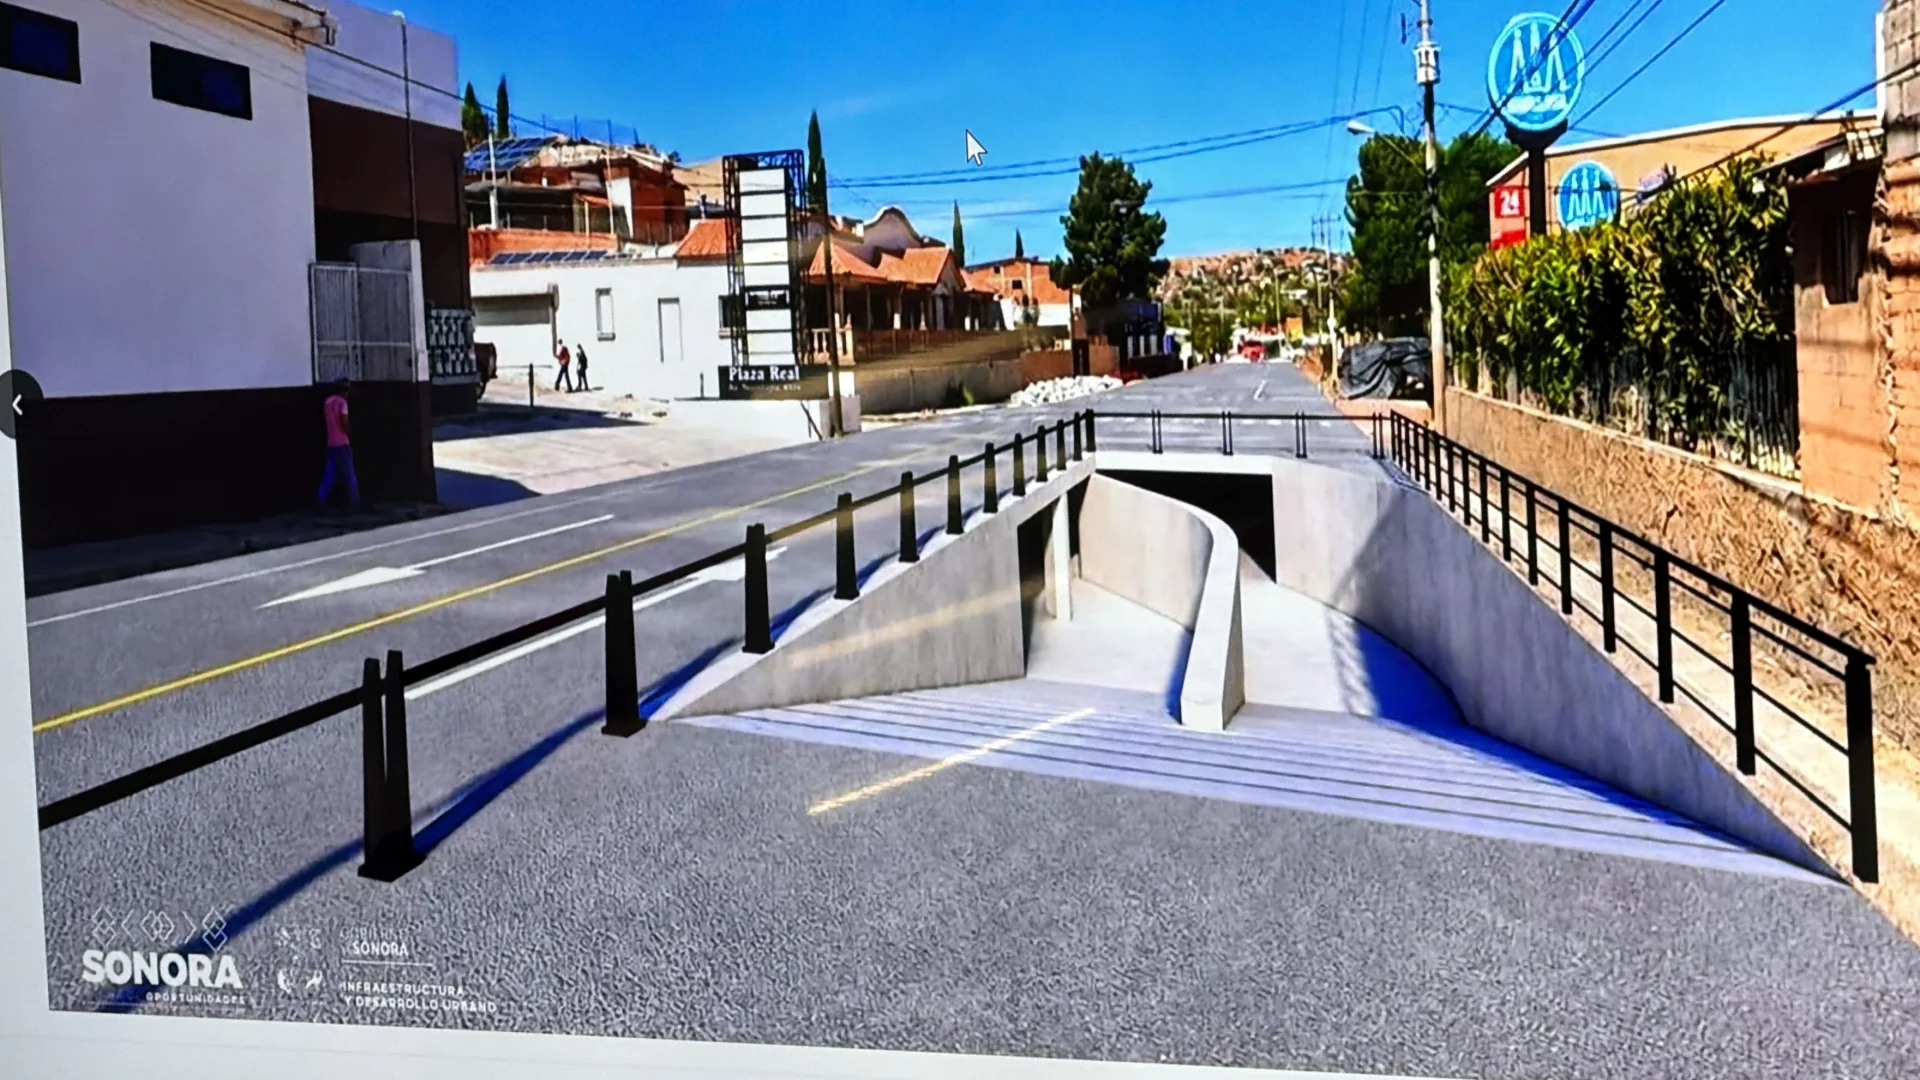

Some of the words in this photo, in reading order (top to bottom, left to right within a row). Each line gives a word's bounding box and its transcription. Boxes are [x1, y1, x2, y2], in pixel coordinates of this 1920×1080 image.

[1500, 190, 1520, 216] 24
[729, 366, 765, 381] Plaza
[770, 365, 800, 381] Real
